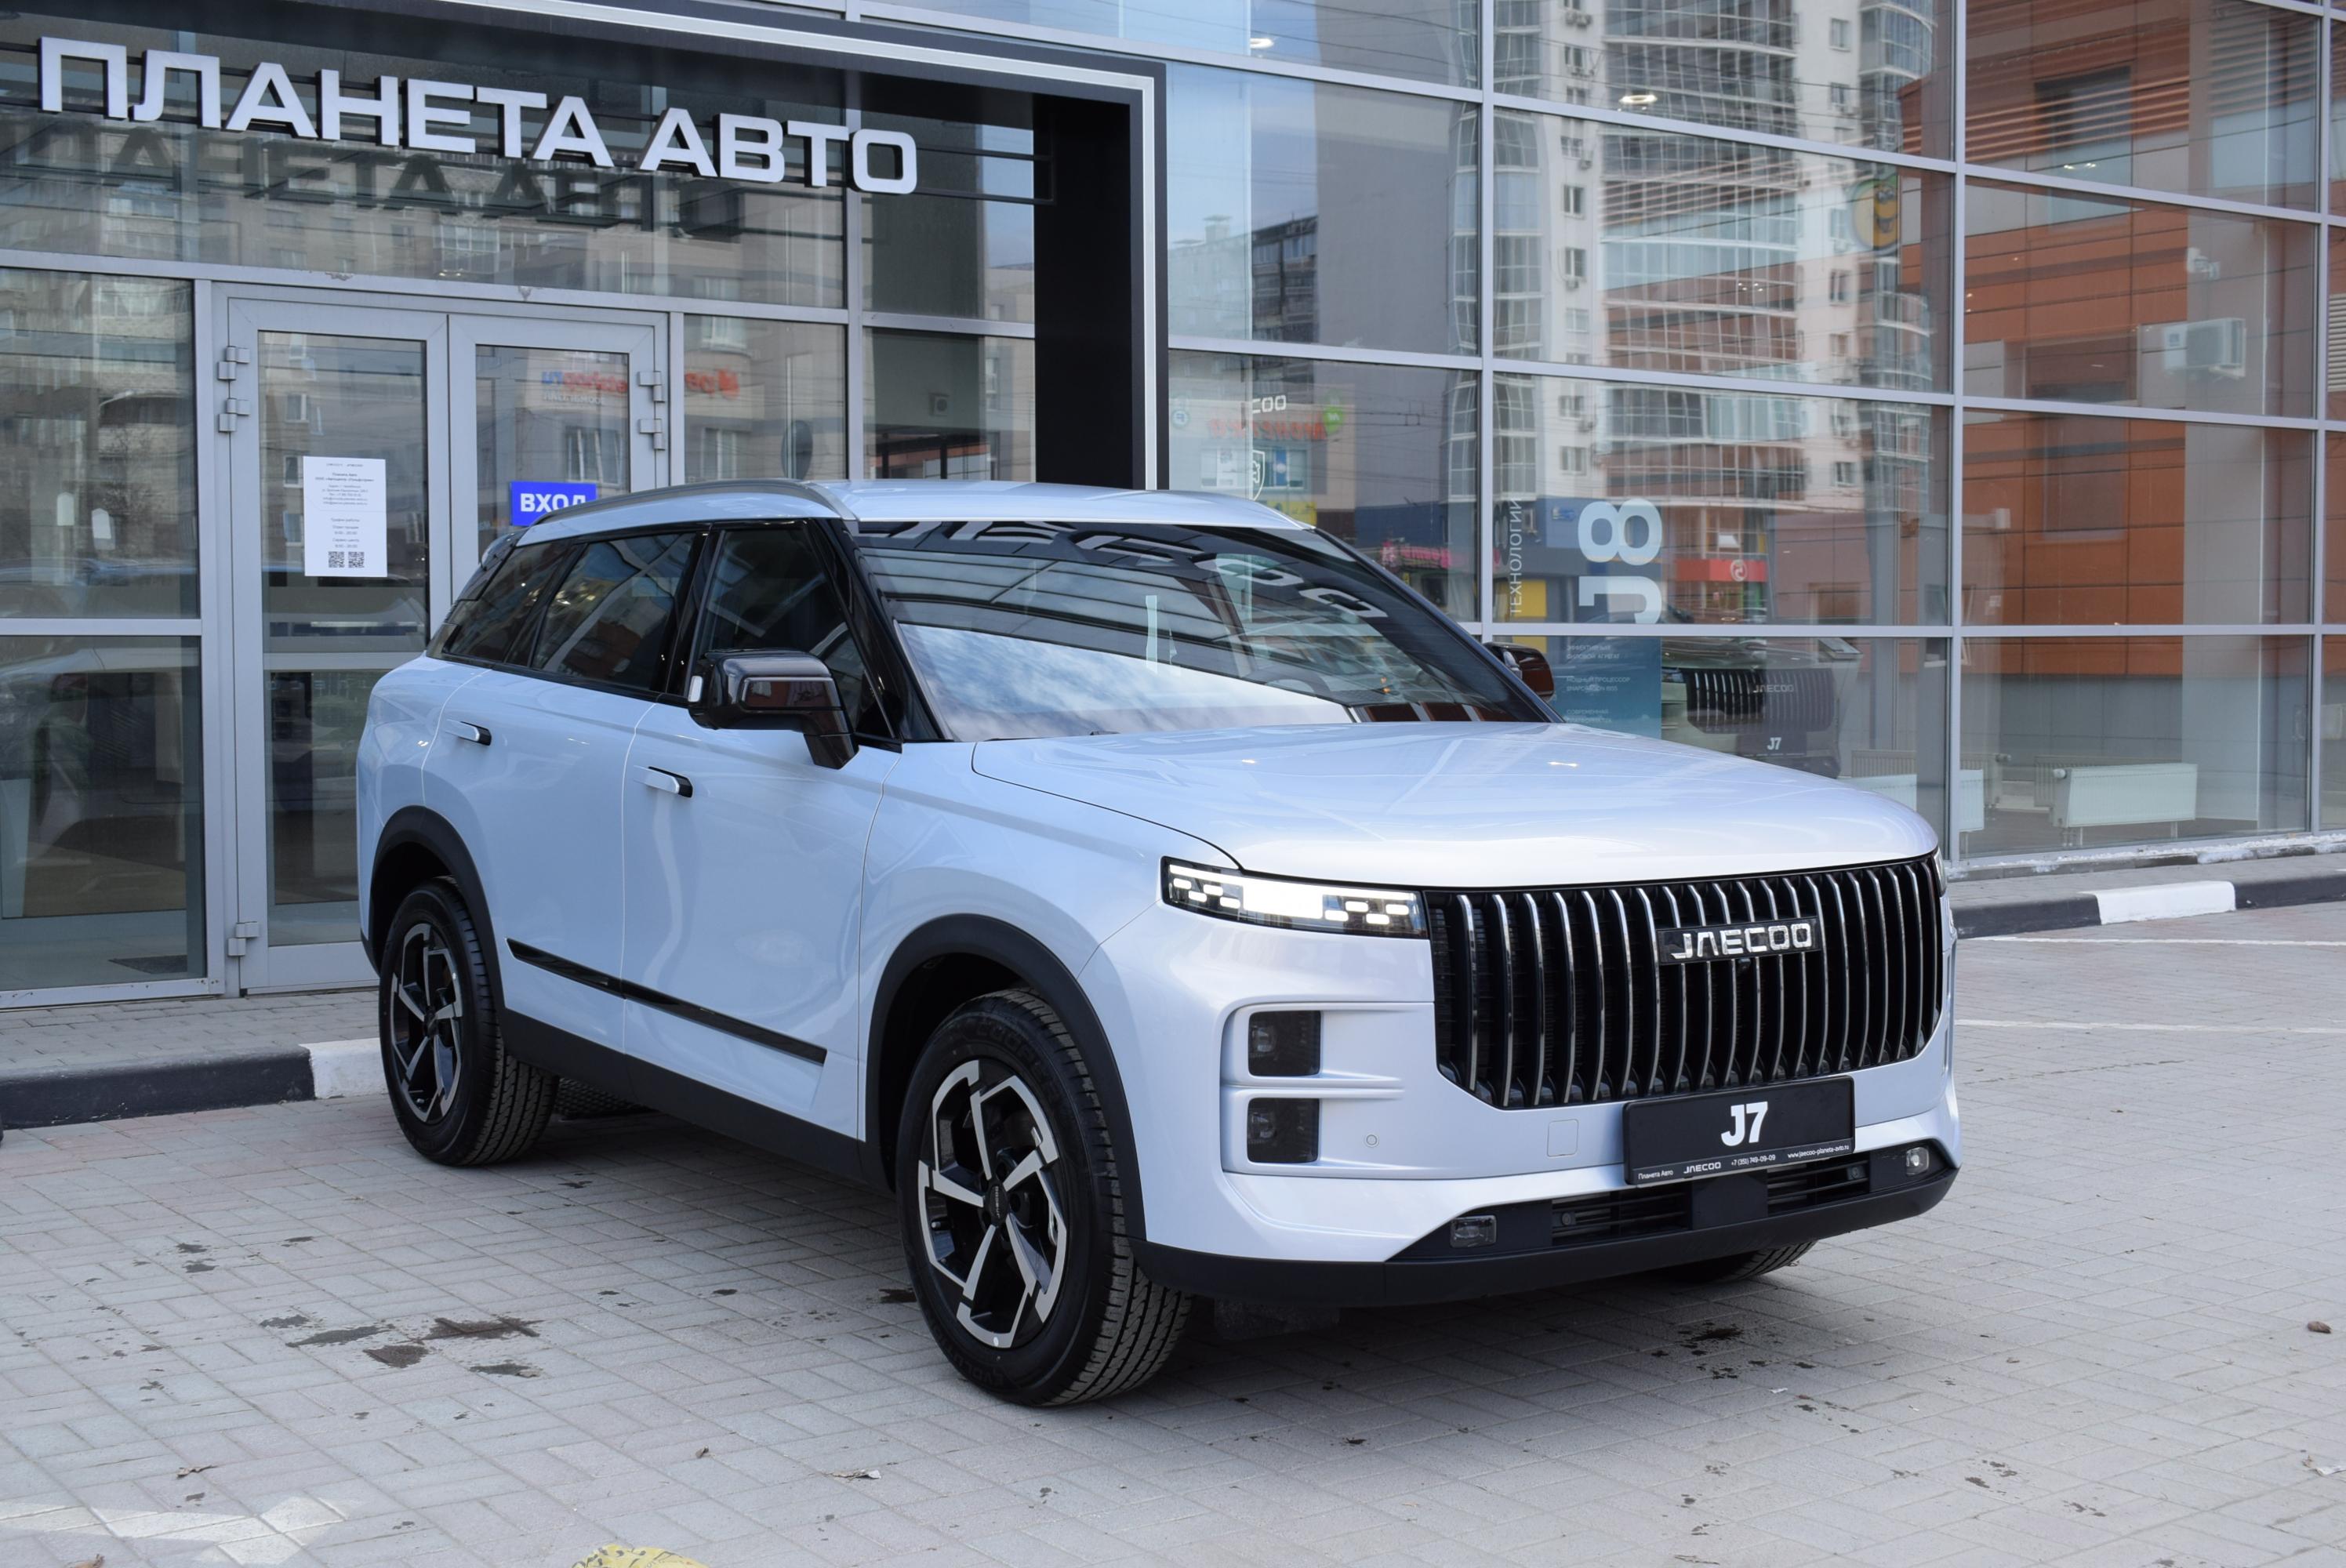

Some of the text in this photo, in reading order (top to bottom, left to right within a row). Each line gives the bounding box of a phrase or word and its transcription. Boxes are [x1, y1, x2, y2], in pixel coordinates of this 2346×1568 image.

[38, 35, 917, 194] ПЛАНЕТА АВТО
[1509, 498, 1523, 615] ТЕХНОЛОГИИ
[1578, 499, 1662, 624] J8
[1767, 737, 1782, 750] J7
[1670, 923, 1812, 960] JAECOO
[1720, 1102, 1768, 1147] J7
[1638, 1171, 1661, 1180] Планета
[1683, 1162, 1722, 1174] JAECOO
[1749, 1154, 1776, 1163] 749-09-09
